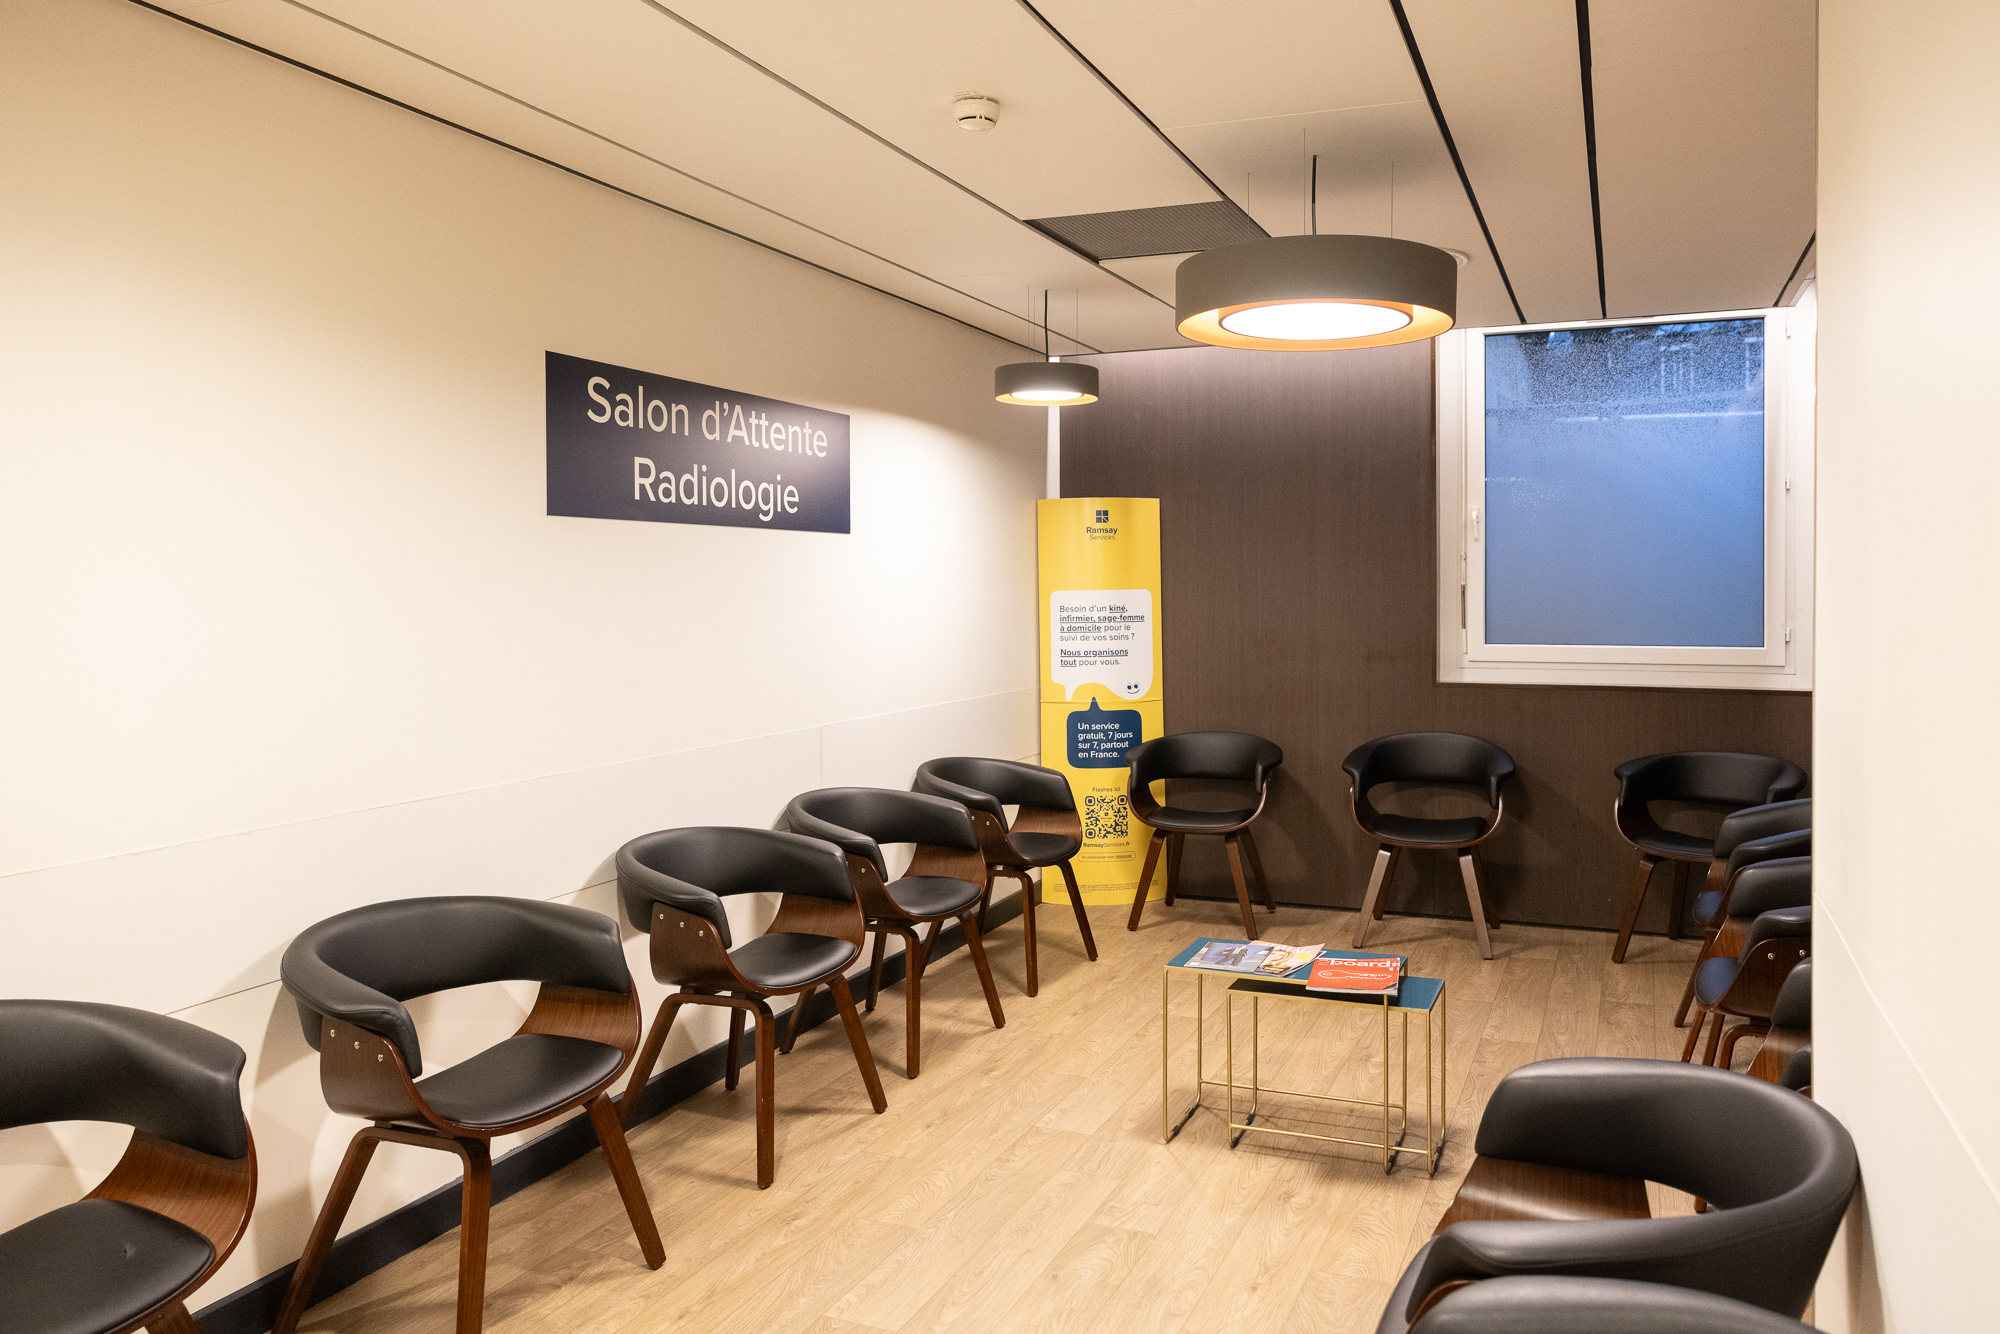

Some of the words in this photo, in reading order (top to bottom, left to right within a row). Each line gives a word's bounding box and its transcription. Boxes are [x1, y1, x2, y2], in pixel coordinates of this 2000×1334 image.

[587, 376, 689, 436] Salon
[702, 401, 828, 458] d’Attente
[634, 456, 800, 522] Radiologie
[1086, 527, 1117, 535] Ramsay
[1060, 605, 1086, 613] Besoin
[1109, 604, 1128, 613] kiné,
[1060, 615, 1096, 623] infirmier,
[1097, 614, 1145, 623] sage-femme
[1067, 624, 1102, 632] domicile
[1084, 648, 1128, 657] organisons
[1077, 732, 1106, 741] gratuit,
[1108, 731, 1113, 739] 7
[1114, 731, 1133, 740] jours
[1092, 741, 1099, 749] 7,
[1101, 741, 1129, 750] partout
[1091, 750, 1120, 758] France.
